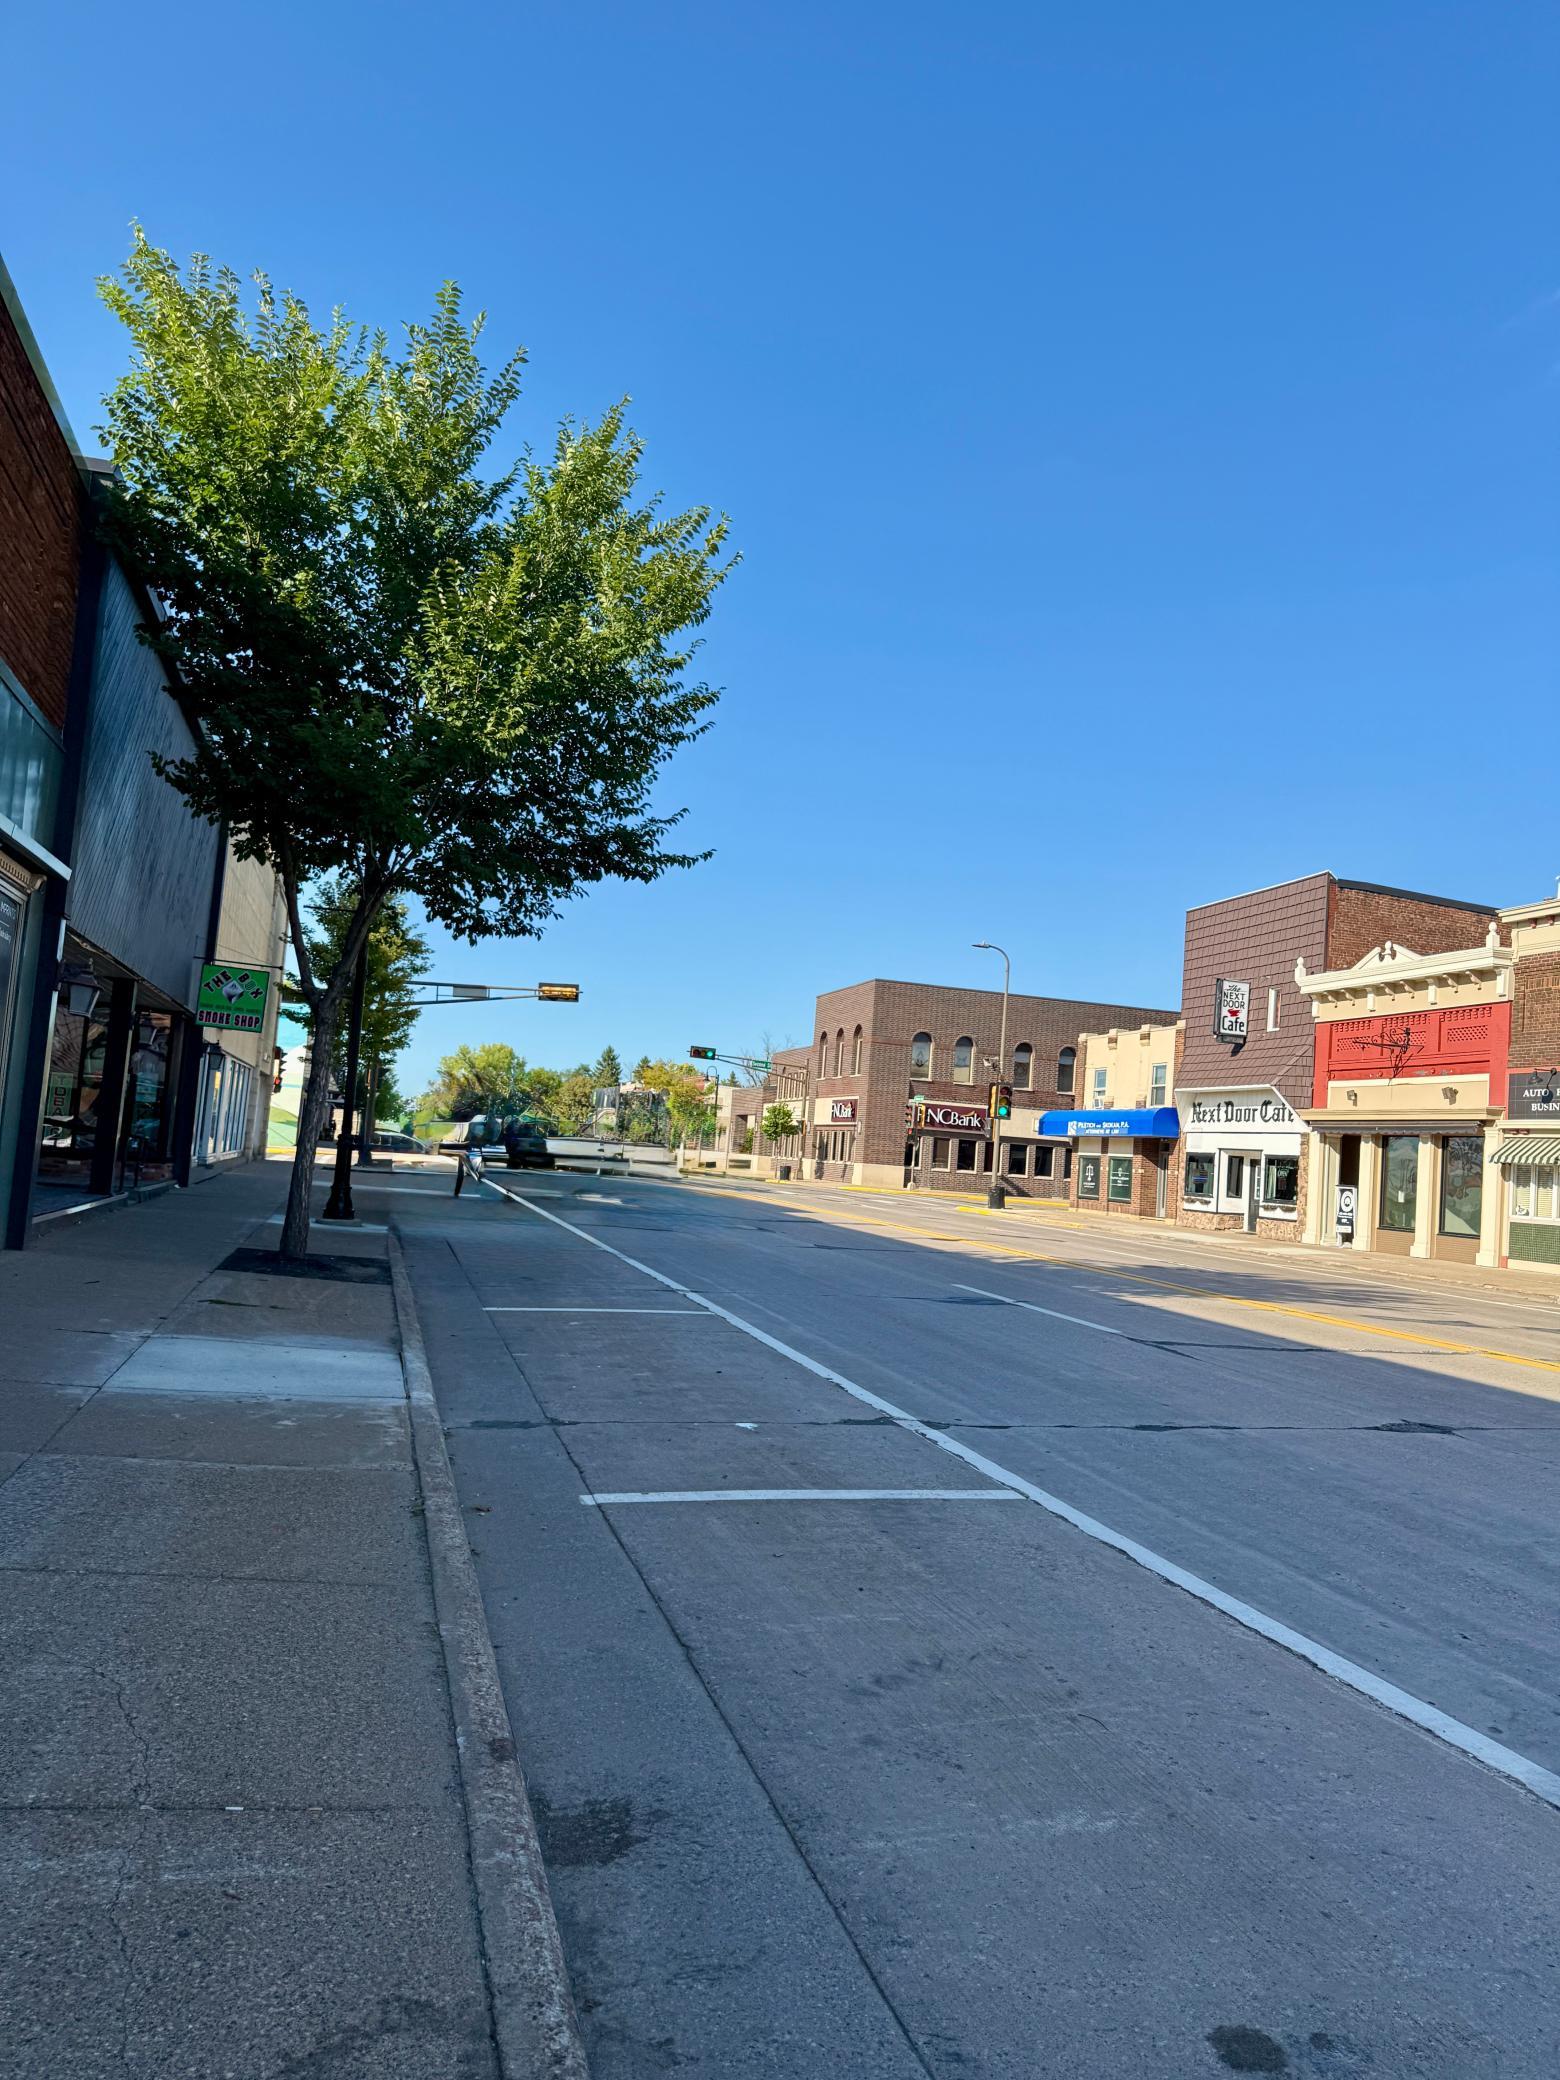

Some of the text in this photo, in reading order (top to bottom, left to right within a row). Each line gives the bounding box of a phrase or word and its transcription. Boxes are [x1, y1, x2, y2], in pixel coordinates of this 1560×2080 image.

[202, 969, 264, 999] THE BOX
[1225, 984, 1242, 993] The
[1223, 991, 1246, 1001] NEXT
[1223, 1000, 1245, 1009] DOOR
[198, 1009, 260, 1028] SMOKE SHOP
[1221, 1015, 1245, 1033] Cafe
[1523, 1089, 1549, 1097] AUTO
[1190, 1102, 1222, 1123] Next
[1224, 1100, 1258, 1123] Door
